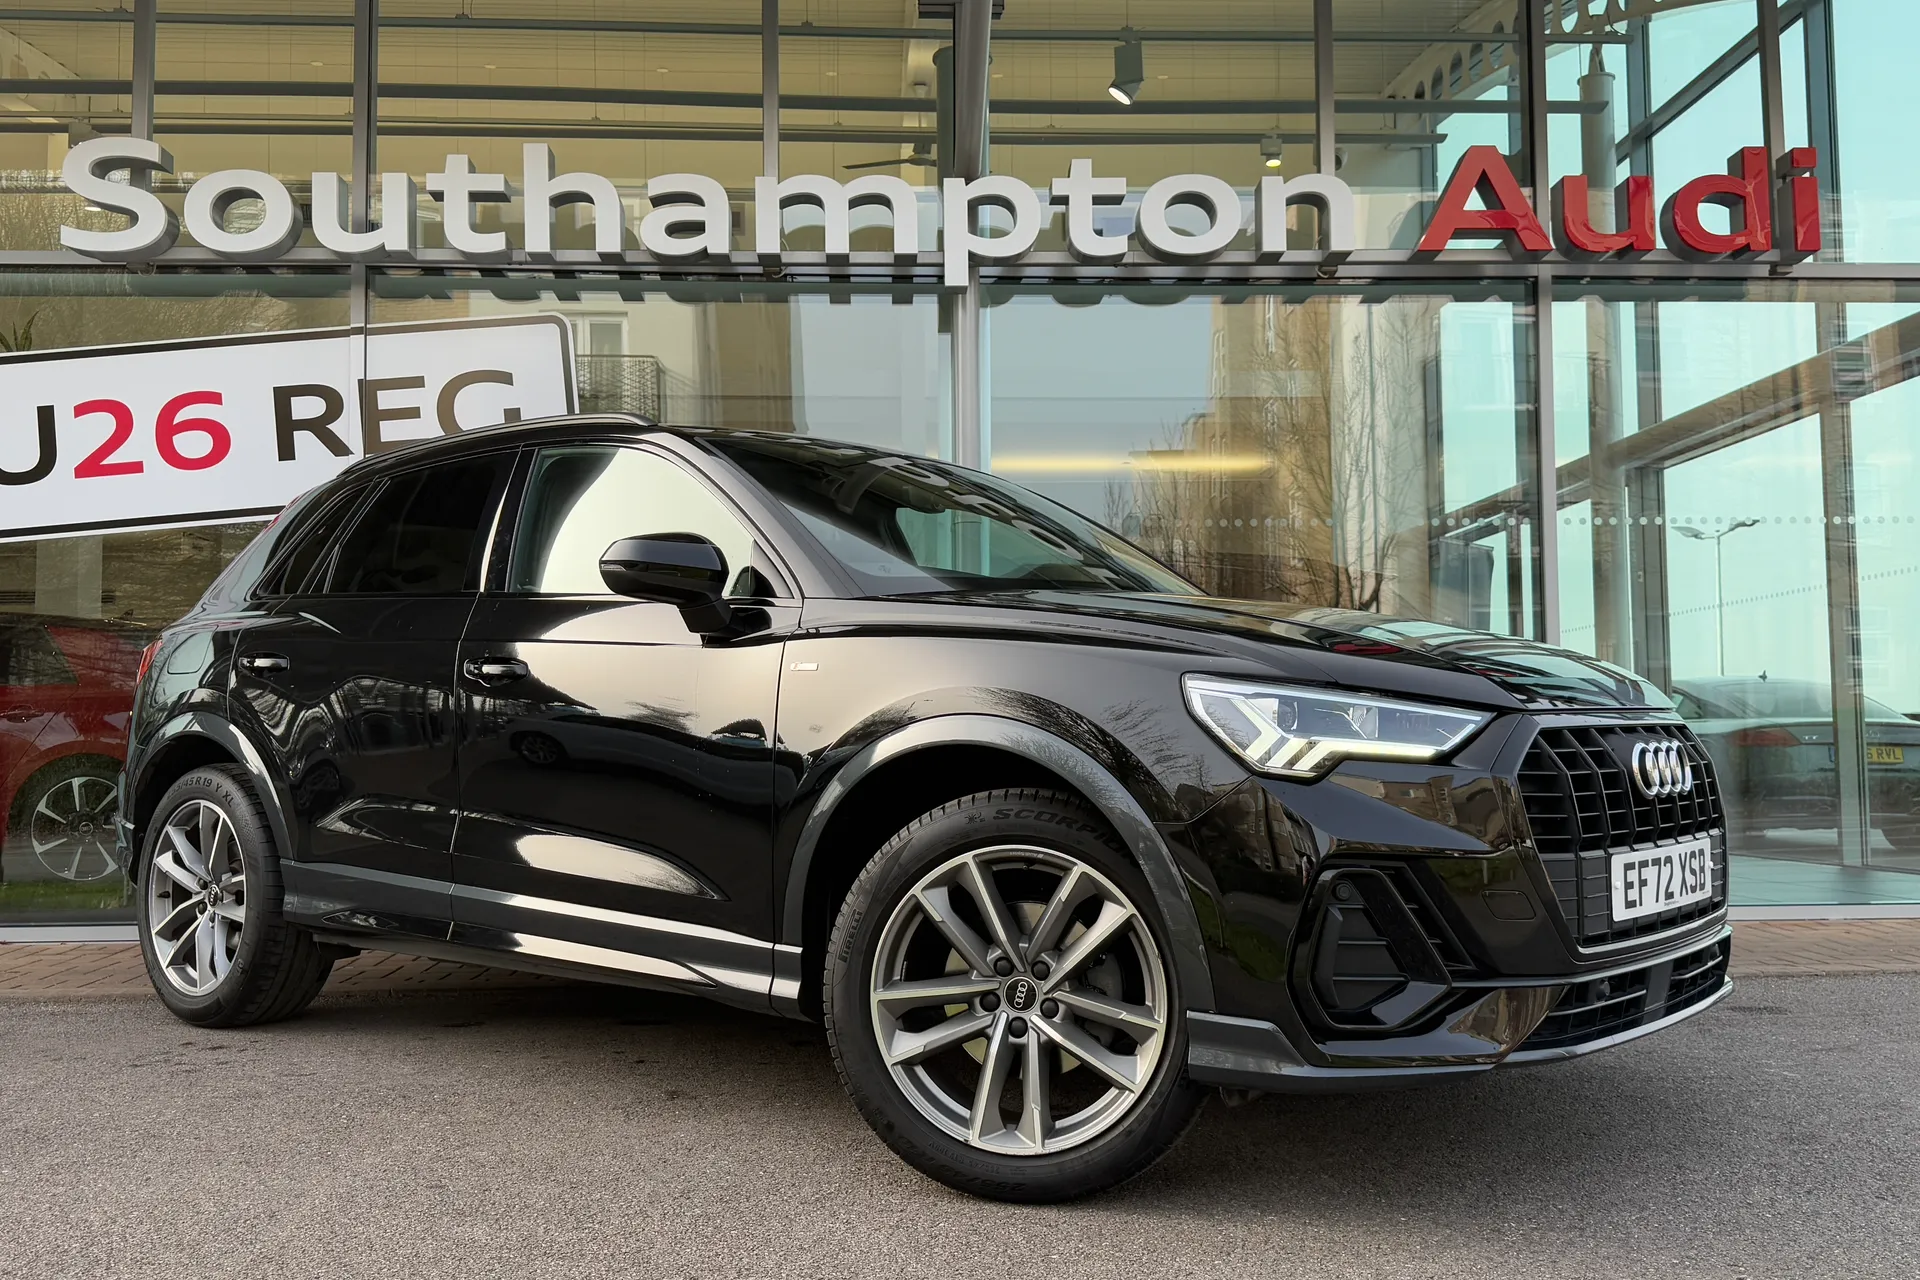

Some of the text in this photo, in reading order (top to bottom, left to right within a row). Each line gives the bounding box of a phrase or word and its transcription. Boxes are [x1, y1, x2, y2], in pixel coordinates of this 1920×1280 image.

[60, 137, 1821, 288] Southampton Audi
[273, 369, 522, 462] REG
[1876, 748, 1902, 760] RVL
[1623, 848, 1706, 909] EF72 XSB
[837, 908, 863, 963] PIRELLI
